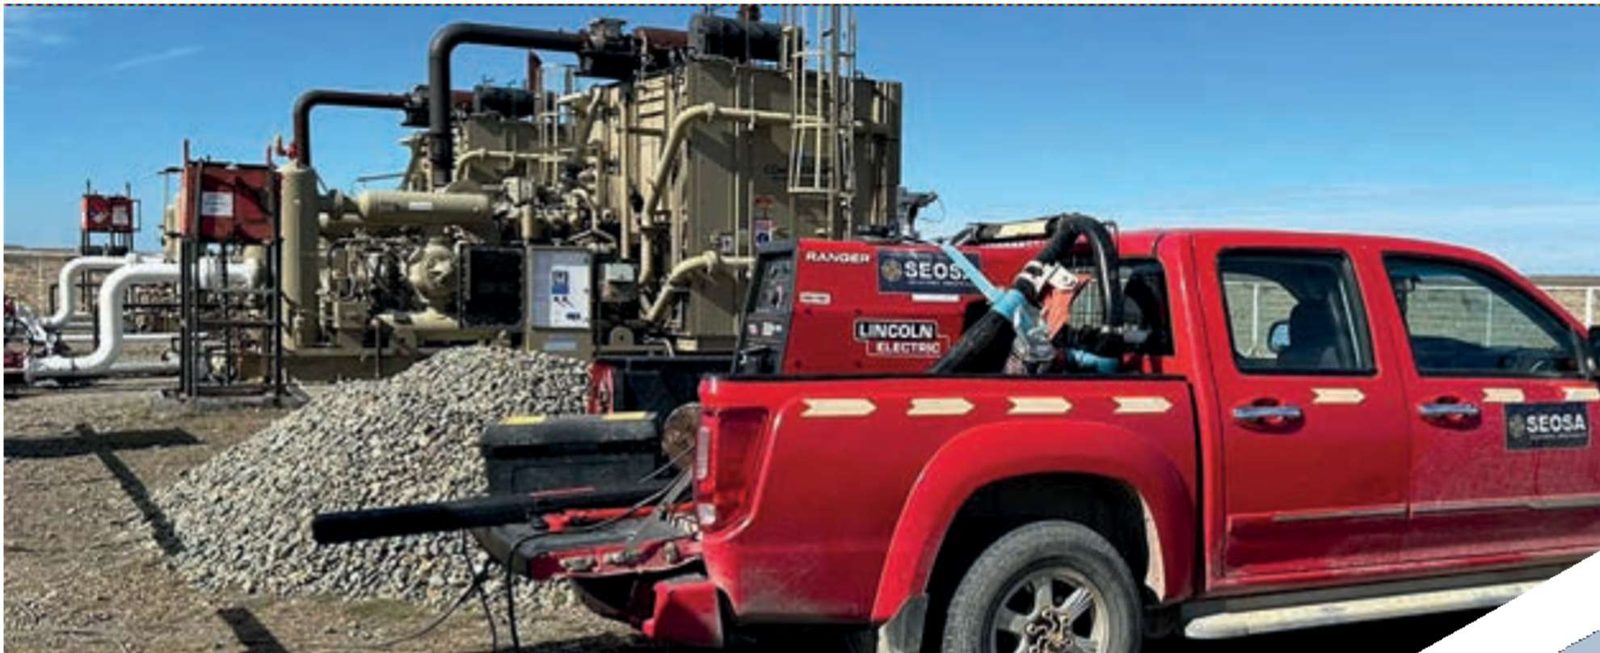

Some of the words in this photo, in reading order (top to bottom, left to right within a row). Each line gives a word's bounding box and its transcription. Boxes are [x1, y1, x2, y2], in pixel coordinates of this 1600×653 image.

[806, 252, 870, 263] RANGER
[904, 261, 969, 280] SEOS
[859, 322, 933, 339] LINCOLN
[876, 342, 940, 354] ELECTRIC
[1526, 413, 1586, 433] SEOSA
